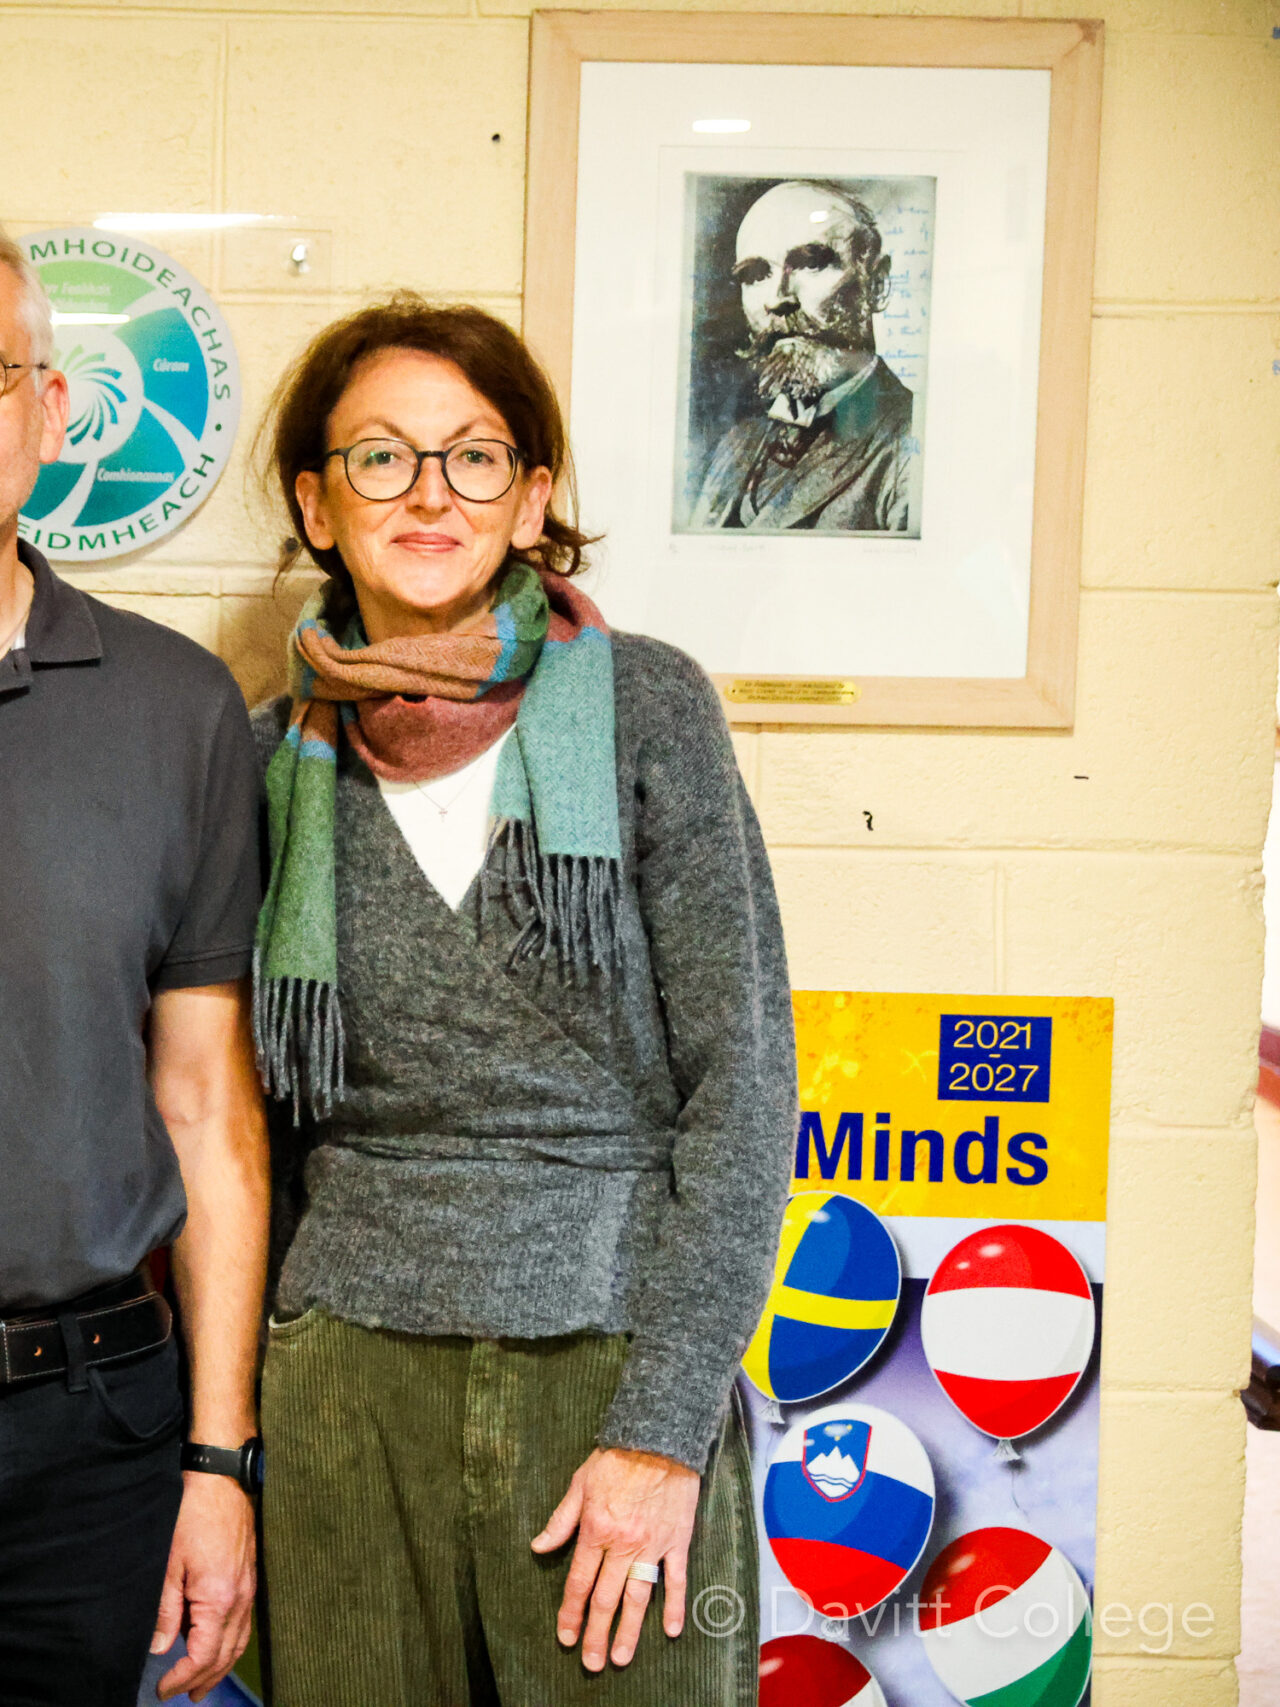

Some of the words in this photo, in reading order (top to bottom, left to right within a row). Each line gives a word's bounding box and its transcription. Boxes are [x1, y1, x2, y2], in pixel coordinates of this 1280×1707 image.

[29, 238, 232, 401] MHOIDEACHAS
[17, 452, 216, 551] IDMHEACH
[953, 1019, 1032, 1050] 2021
[948, 1062, 1040, 1092] 2027
[794, 1110, 1049, 1186] Minds
